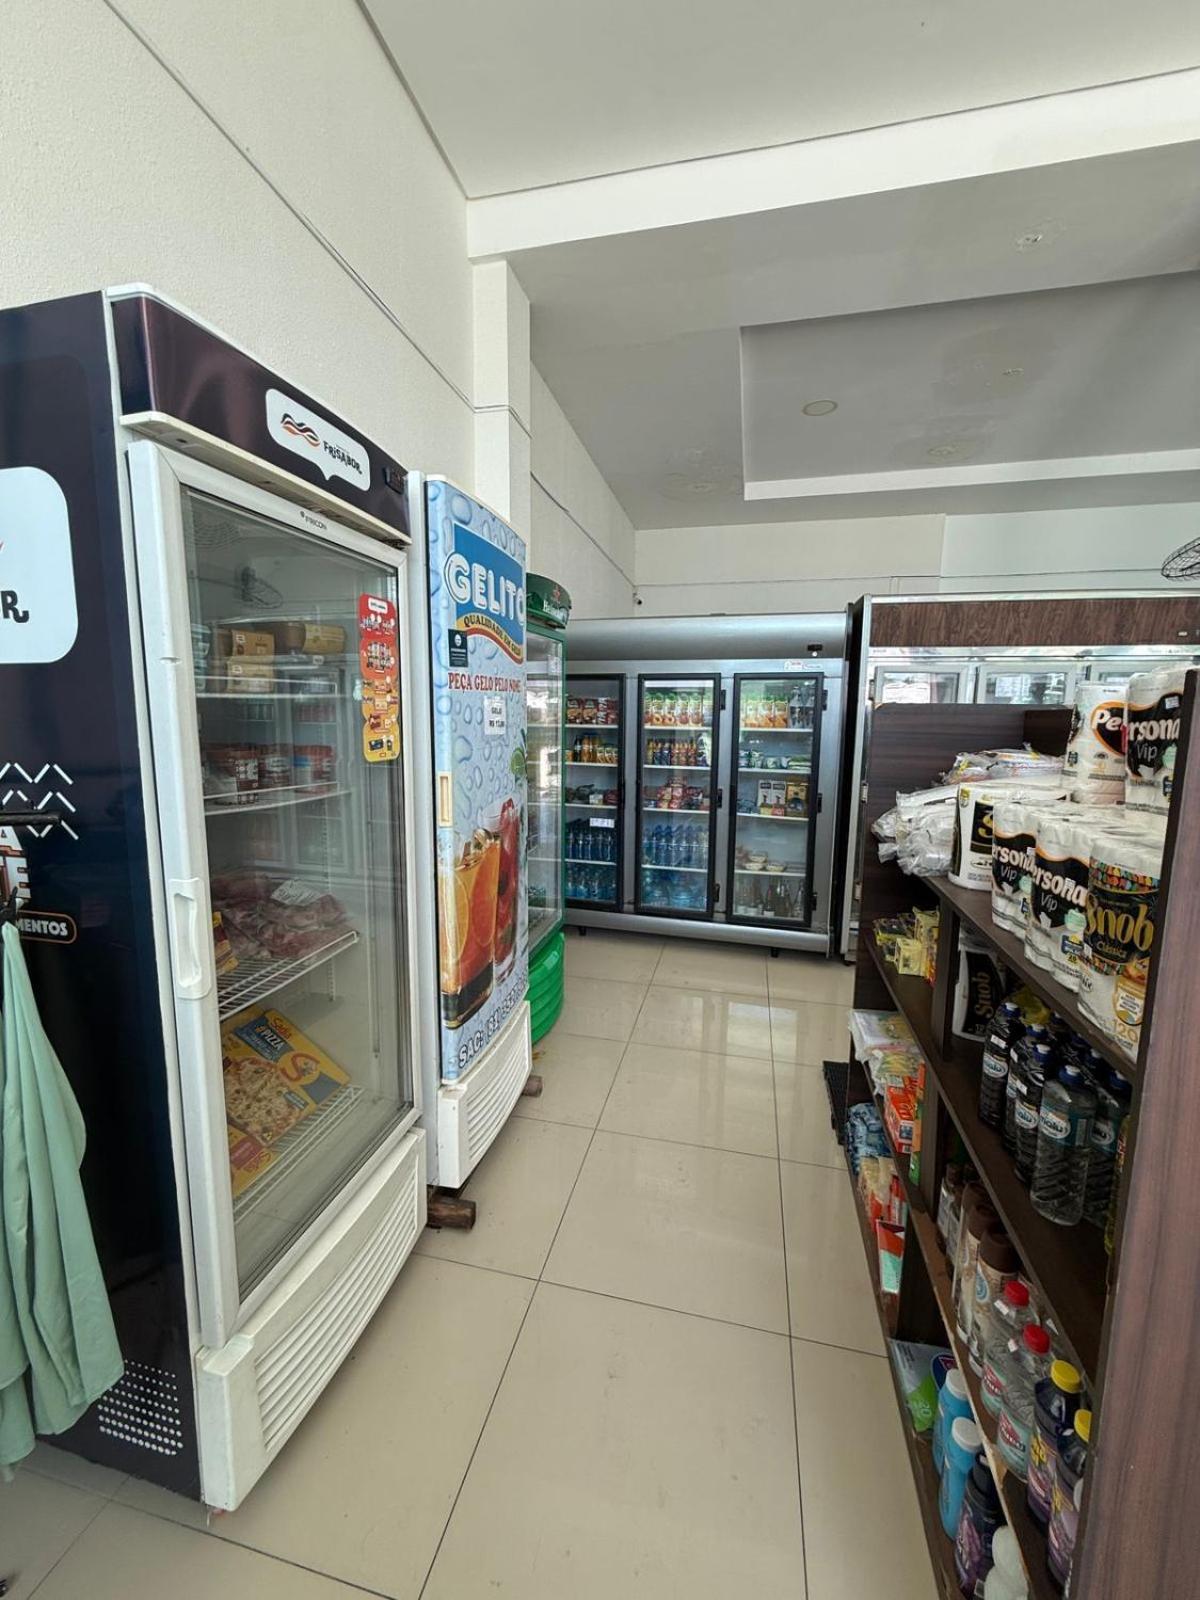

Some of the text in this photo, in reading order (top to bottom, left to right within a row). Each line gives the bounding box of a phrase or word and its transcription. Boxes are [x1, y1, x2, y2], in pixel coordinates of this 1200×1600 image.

[443, 552, 525, 626] GELITO
[448, 672, 473, 694] PEÇA
[474, 674, 493, 691] GELO
[494, 677, 508, 692] PELO
[1136, 742, 1158, 760] Vip
[1000, 865, 1018, 882] Vip
[1041, 891, 1058, 913] Vip
[1085, 892, 1154, 952] Snob
[971, 970, 995, 1019] Snob
